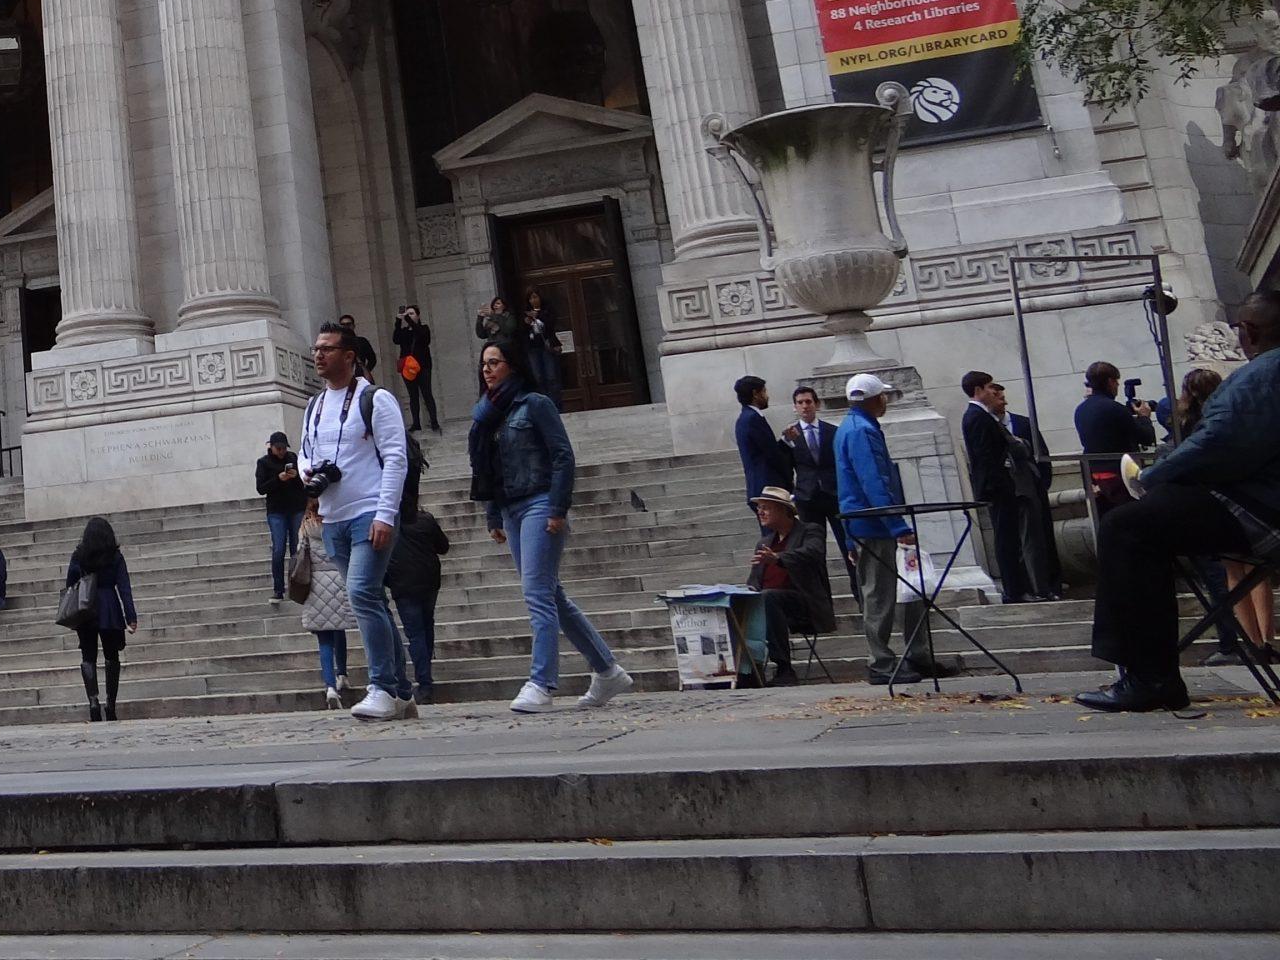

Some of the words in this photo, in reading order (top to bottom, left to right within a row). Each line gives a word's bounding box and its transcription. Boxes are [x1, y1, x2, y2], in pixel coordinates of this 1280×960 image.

[830, 8, 847, 20] 88
[853, 21, 863, 32] 4
[866, 11, 921, 29] Research
[924, 2, 980, 19] Libraries
[839, 29, 1008, 67] NYPL.ORG/LIBRARYCARD
[90, 443, 132, 455] STEPHEN
[143, 434, 211, 449] SCHWARZMAN
